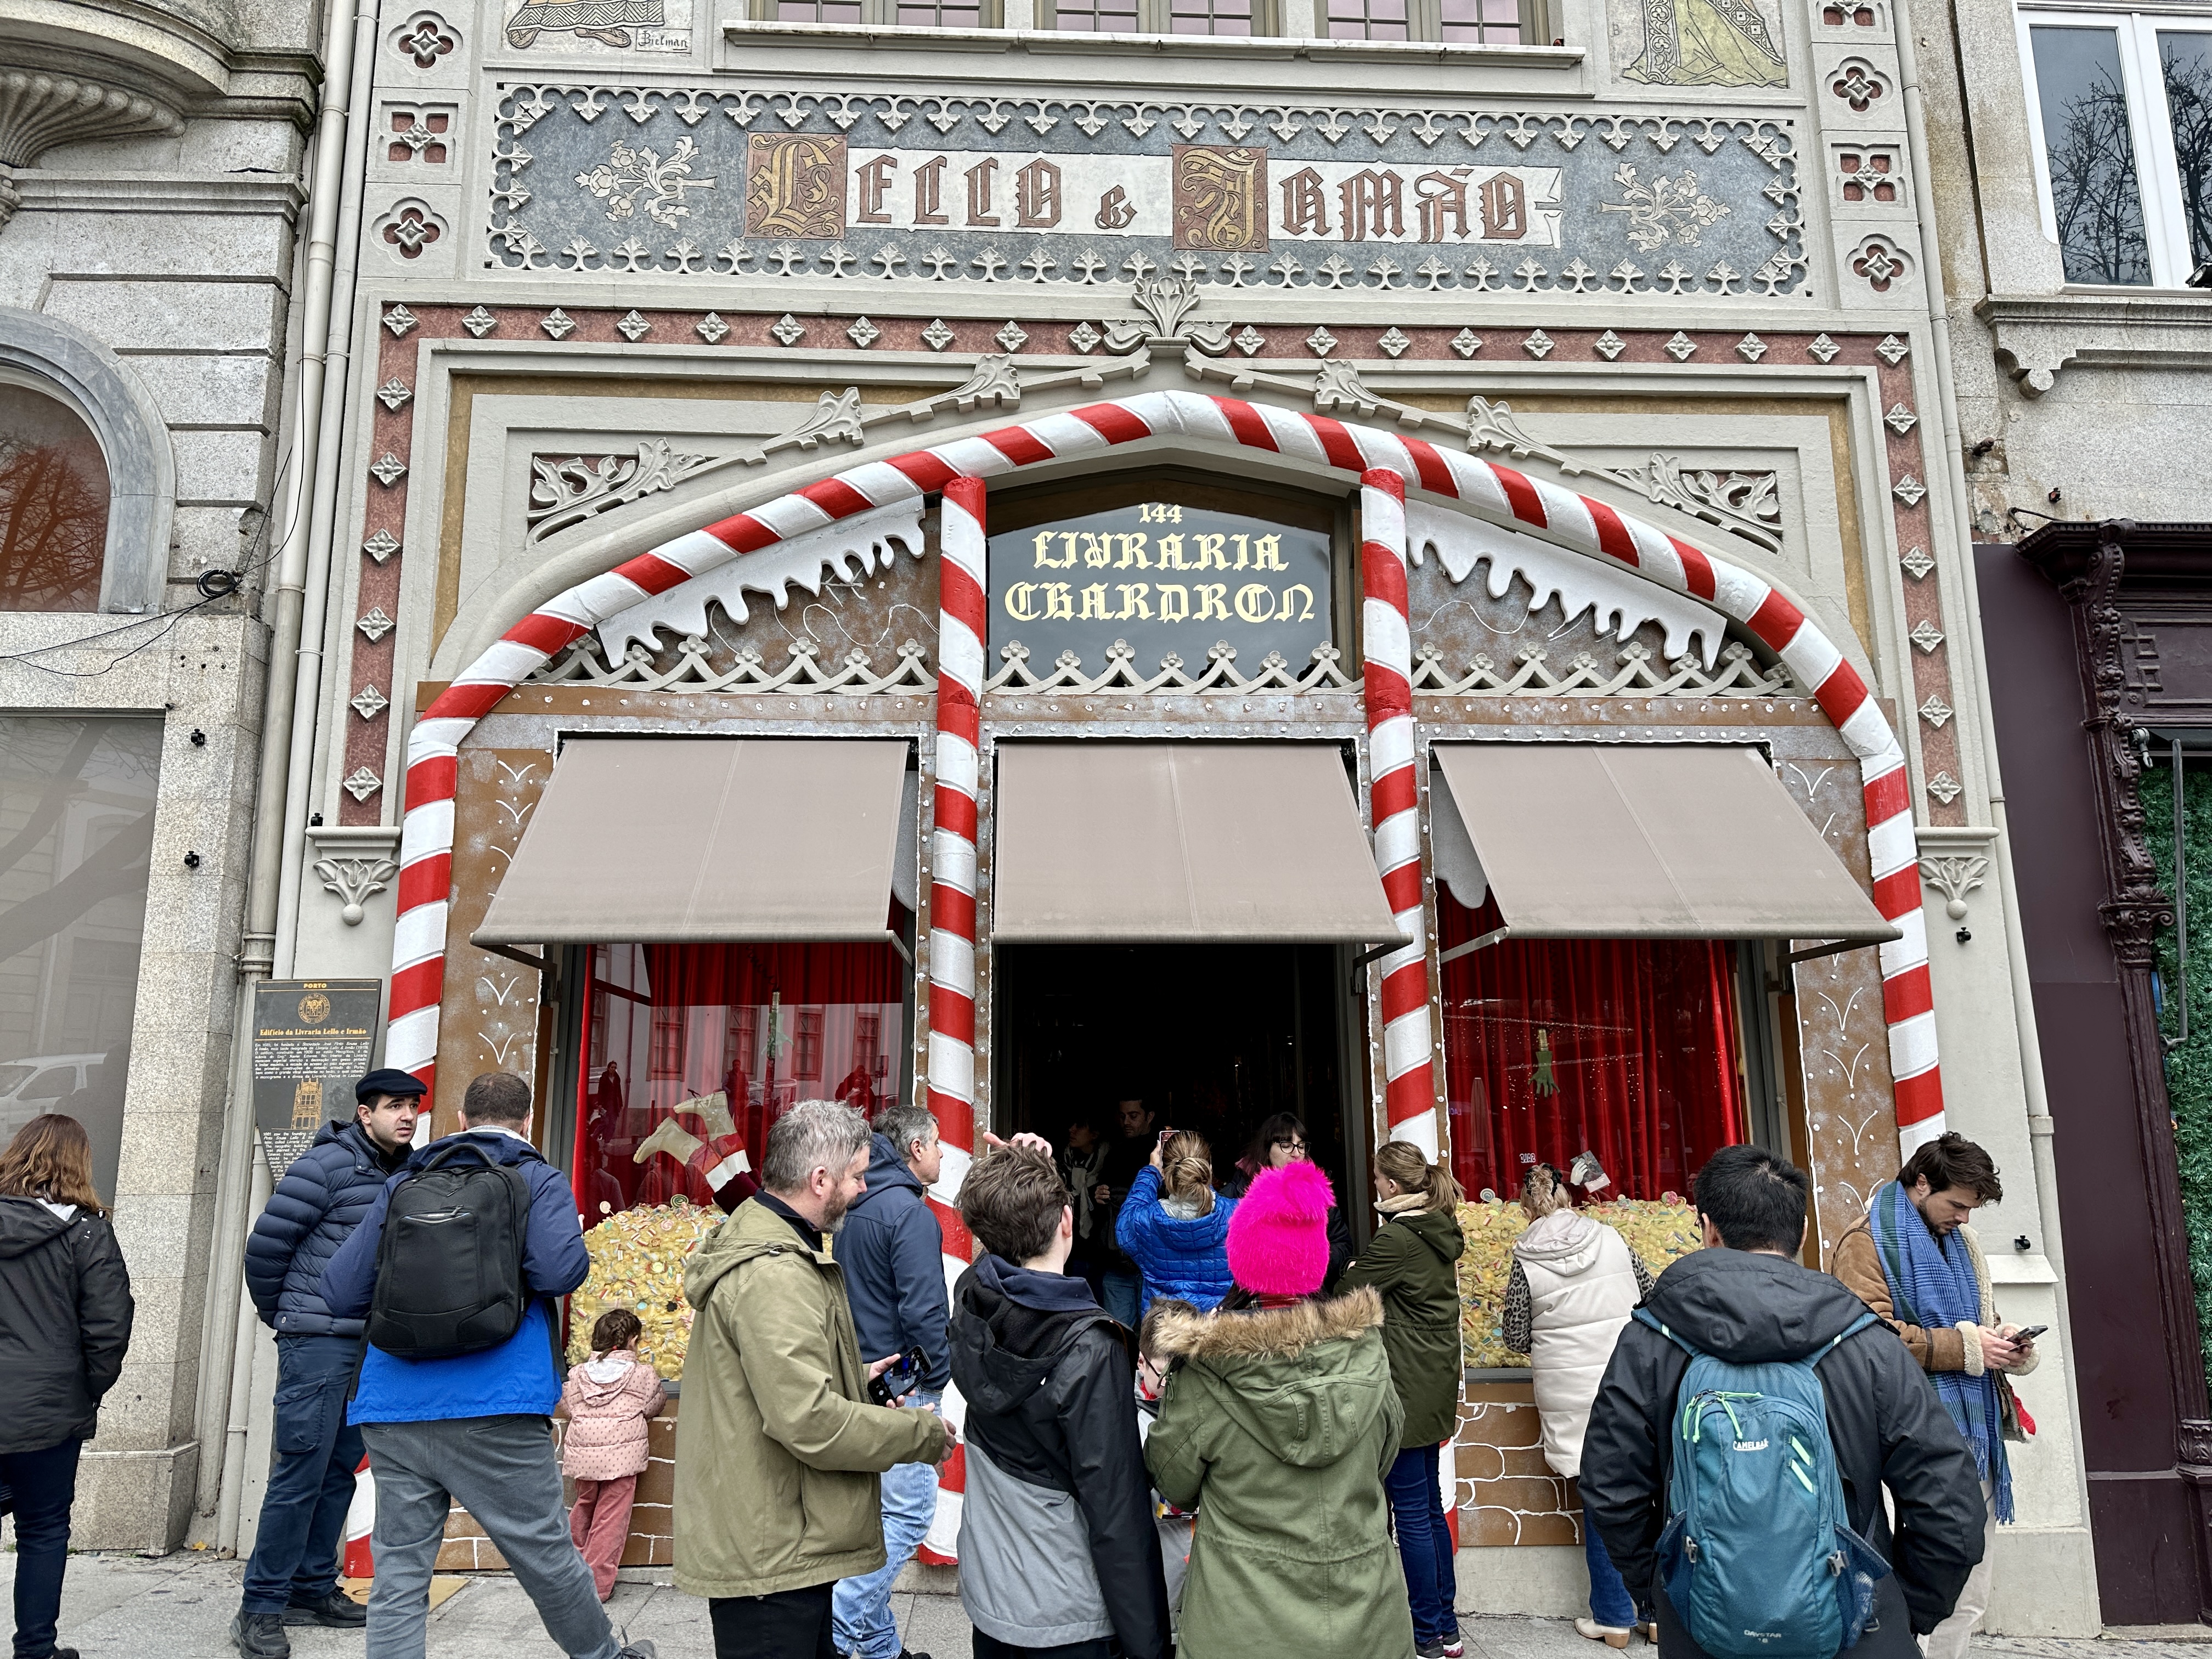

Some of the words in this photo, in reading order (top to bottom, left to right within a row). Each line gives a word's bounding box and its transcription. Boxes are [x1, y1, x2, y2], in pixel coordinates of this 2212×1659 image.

[639, 30, 688, 48] Bielman
[1095, 183, 1137, 230] &
[1138, 503, 1183, 524] 144
[1733, 1438, 1769, 1451] CAMELBAK
